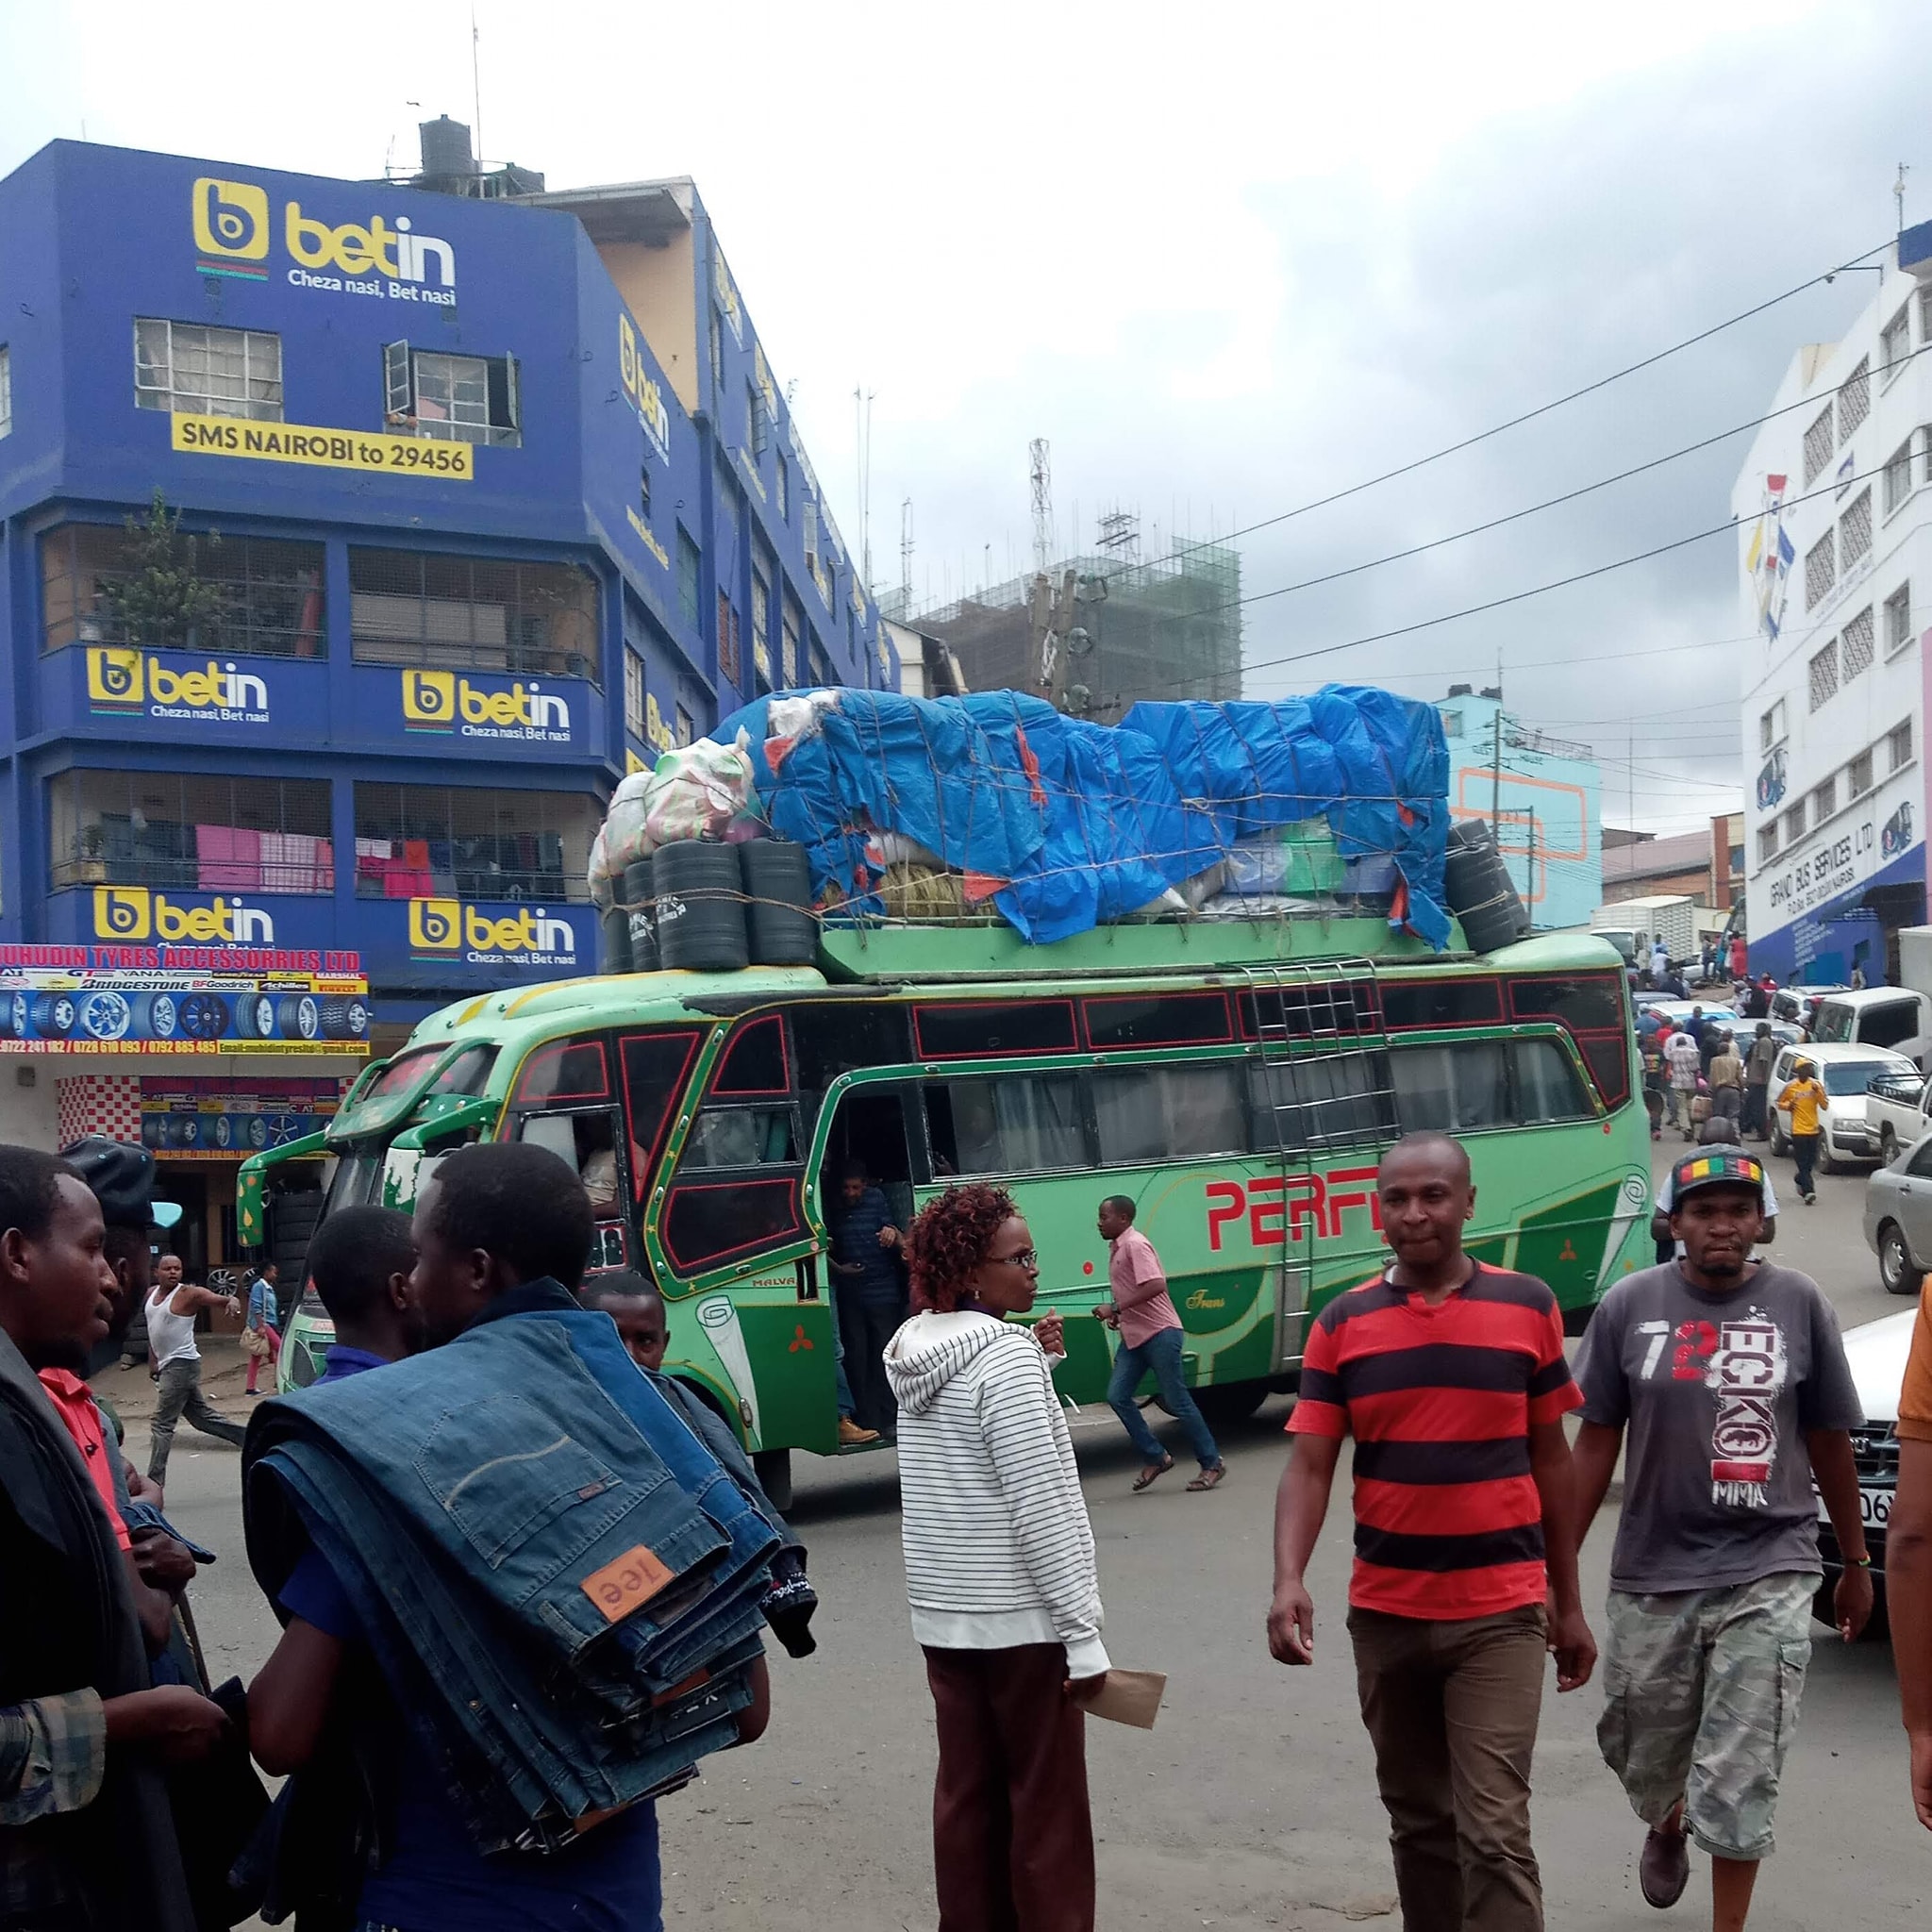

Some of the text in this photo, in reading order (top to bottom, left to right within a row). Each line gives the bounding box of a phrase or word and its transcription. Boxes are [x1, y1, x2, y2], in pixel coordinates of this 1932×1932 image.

[286, 202, 455, 287] betin
[288, 269, 457, 307] Cheza nasi, Bet nasi
[182, 423, 466, 473] SMS NAIROBI to 29456
[149, 657, 268, 709] betin
[458, 679, 570, 728] betin
[151, 705, 270, 723] Cheza nasi, Bet nasi
[461, 725, 498, 738] Cheza
[525, 728, 547, 741] Bet
[549, 730, 571, 742] nasi
[155, 894, 275, 942] betin
[465, 906, 575, 952] betin
[92, 946, 158, 968] TYRES
[162, 947, 321, 972] ACCESSORRIES
[325, 950, 360, 973] LTD
[466, 951, 504, 964] Cheza
[531, 953, 553, 965] Bet
[555, 955, 576, 966] nasi
[192, 980, 254, 989] BFGoodrich
[1206, 1166, 1386, 1253] PERF
[753, 1277, 796, 1287] MALVA
[1713, 1322, 1775, 1459] ECKO
